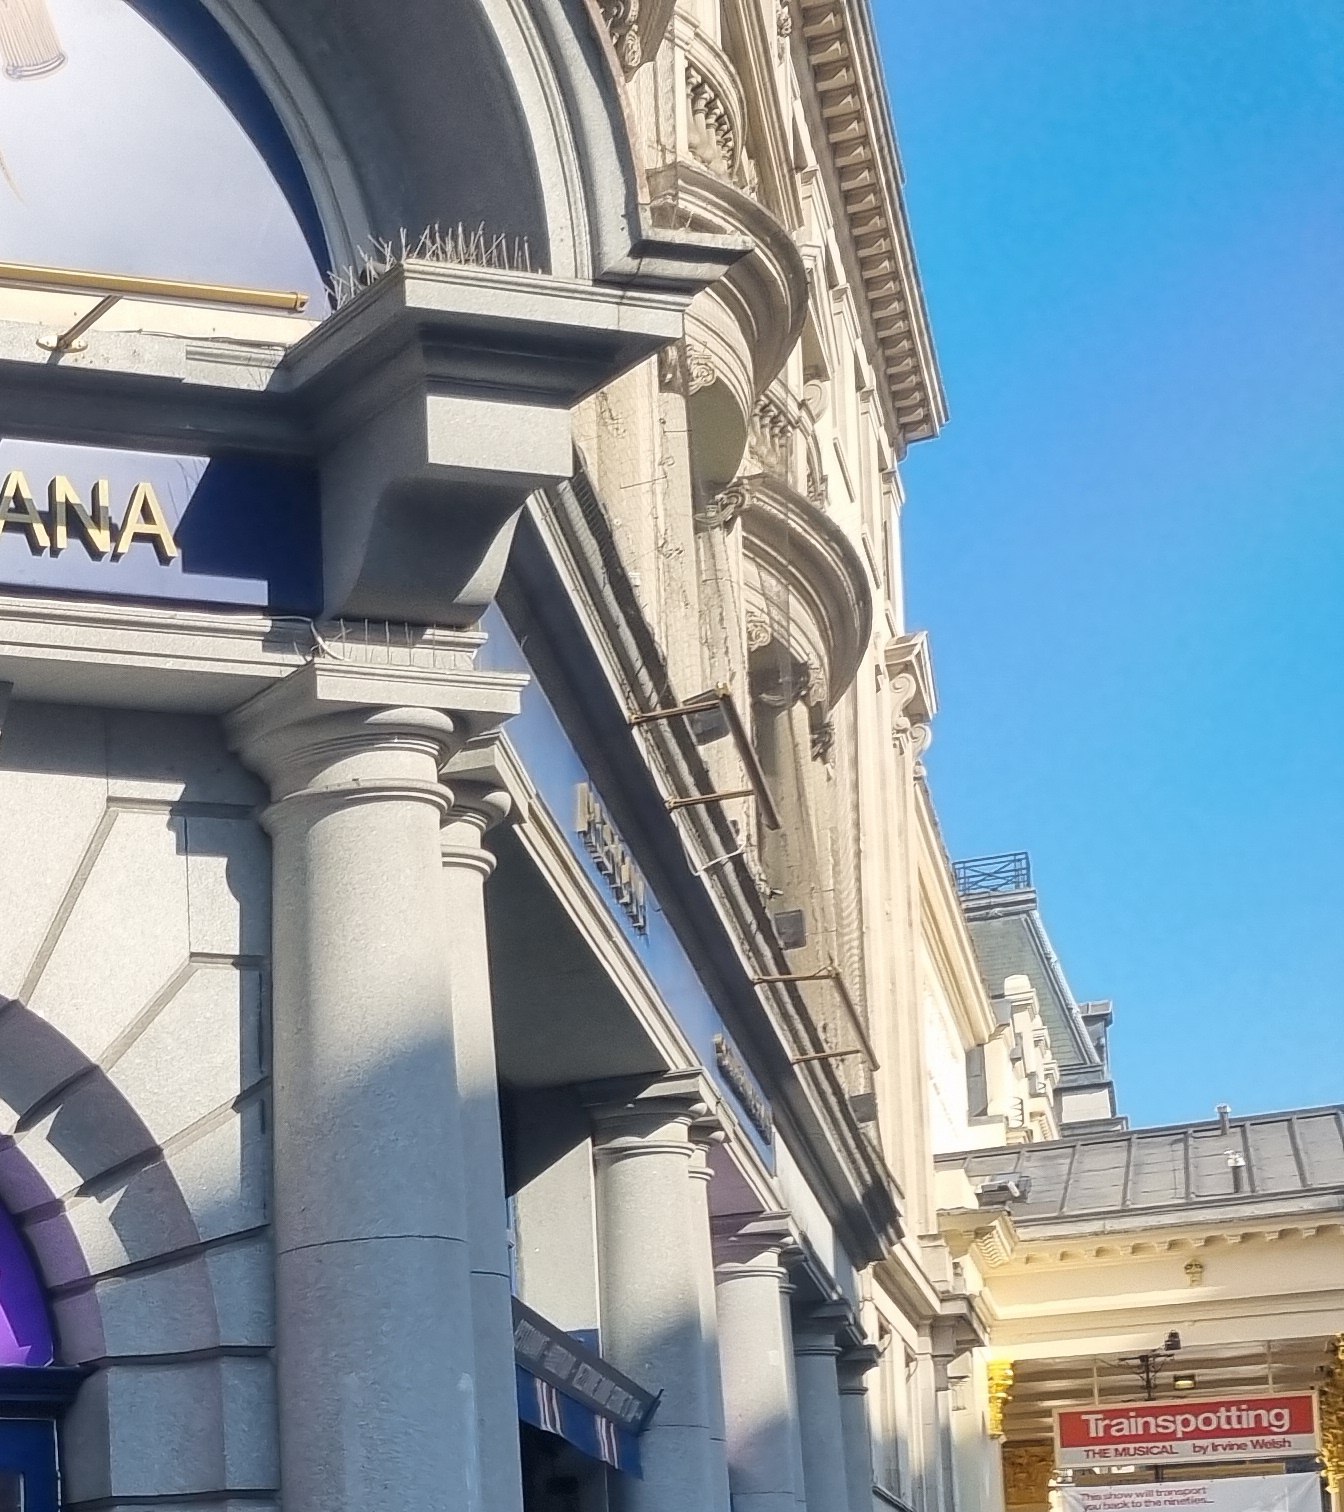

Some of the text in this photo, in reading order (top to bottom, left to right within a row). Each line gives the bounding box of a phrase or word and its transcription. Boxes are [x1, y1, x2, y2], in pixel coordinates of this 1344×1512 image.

[1081, 1404, 1291, 1438] Trainspotting
[1084, 1438, 1292, 1460] THE MUSICAL by Irvine Welsh
[1103, 1491, 1133, 1500] show
[1135, 1489, 1154, 1498] will
[1155, 1486, 1207, 1497] transport
[1083, 1502, 1101, 1512] you
[1102, 1501, 1130, 1511] back
[1131, 1500, 1142, 1509] to
[1144, 1499, 1162, 1508] the
